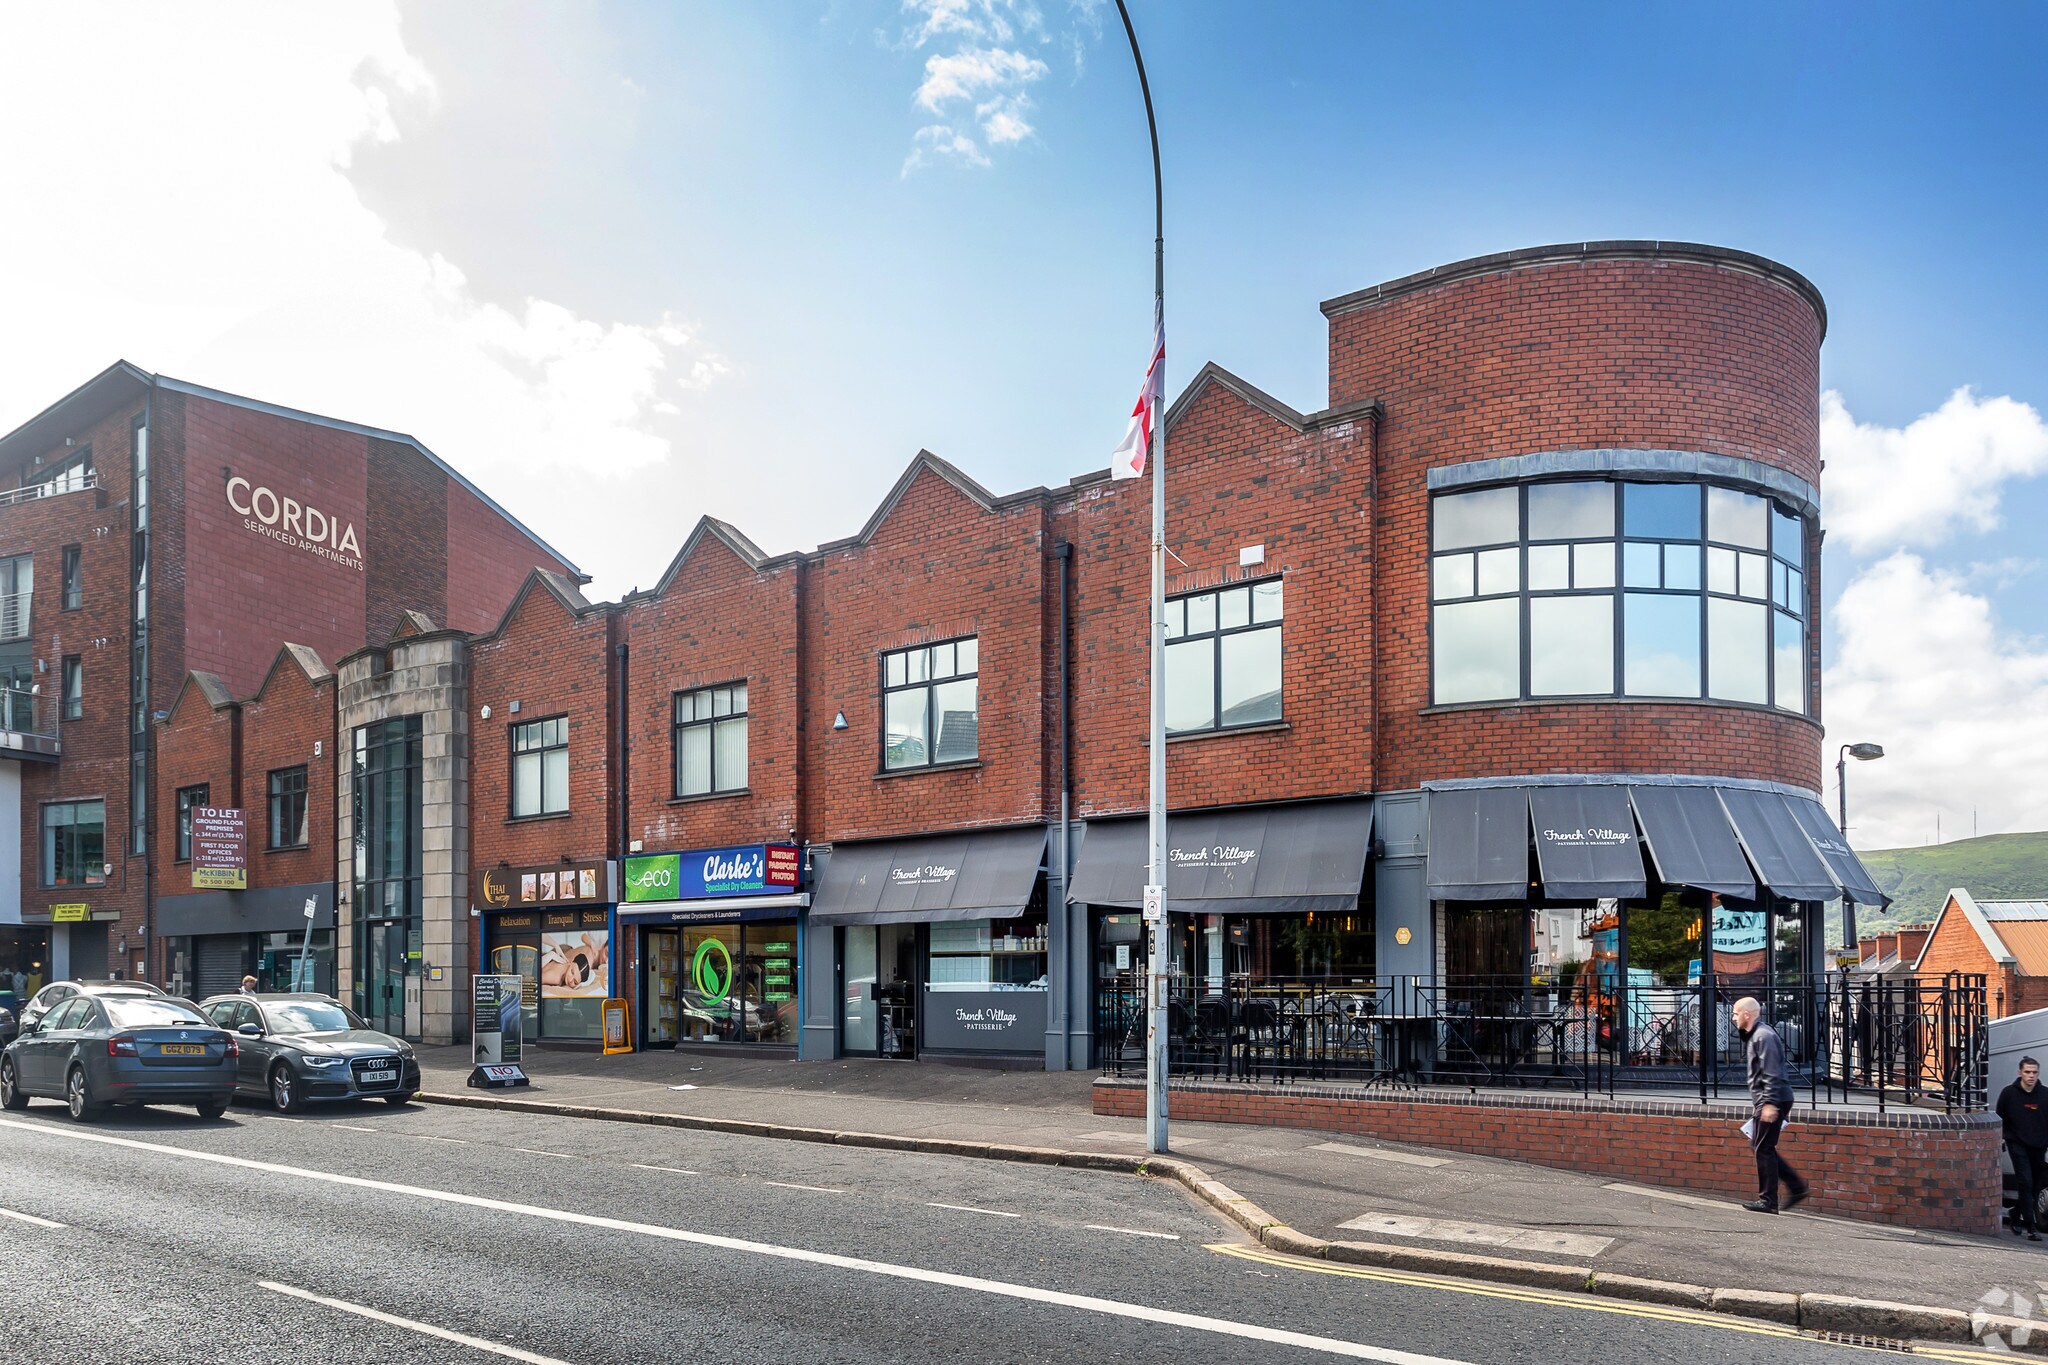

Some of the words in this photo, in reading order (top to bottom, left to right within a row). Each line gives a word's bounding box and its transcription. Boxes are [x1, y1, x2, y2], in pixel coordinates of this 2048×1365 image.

[226, 476, 362, 559] CORDIA
[243, 518, 297, 547] SERVICED
[298, 539, 364, 572] APARTMENTS
[199, 807, 217, 817] TO
[219, 808, 240, 818] LET
[1543, 828, 1585, 841] French
[1587, 828, 1632, 844] Village
[771, 850, 796, 861] INSTANT
[1169, 847, 1208, 862] French
[1212, 846, 1256, 864] Village
[703, 853, 763, 882] Clarke's
[768, 860, 798, 871] PASSPORT
[199, 869, 235, 877] McKIBBIN
[631, 869, 671, 888] eco
[771, 871, 795, 881] PHOTOS
[892, 868, 921, 880] French
[924, 865, 957, 881] Village
[489, 884, 506, 895] THAI
[705, 883, 731, 893] Specialist
[730, 881, 740, 892] Dry
[740, 881, 764, 891] Cleaners
[500, 916, 531, 927] Relaxation
[548, 913, 573, 927] Tranquil
[583, 912, 602, 922] Stress
[671, 913, 691, 921] Specialist
[955, 1008, 985, 1021] French
[985, 1008, 1018, 1027] Village
[966, 1023, 1003, 1031] PATISSERIE
[378, 1072, 389, 1080] 519
[491, 1066, 514, 1075] NO
